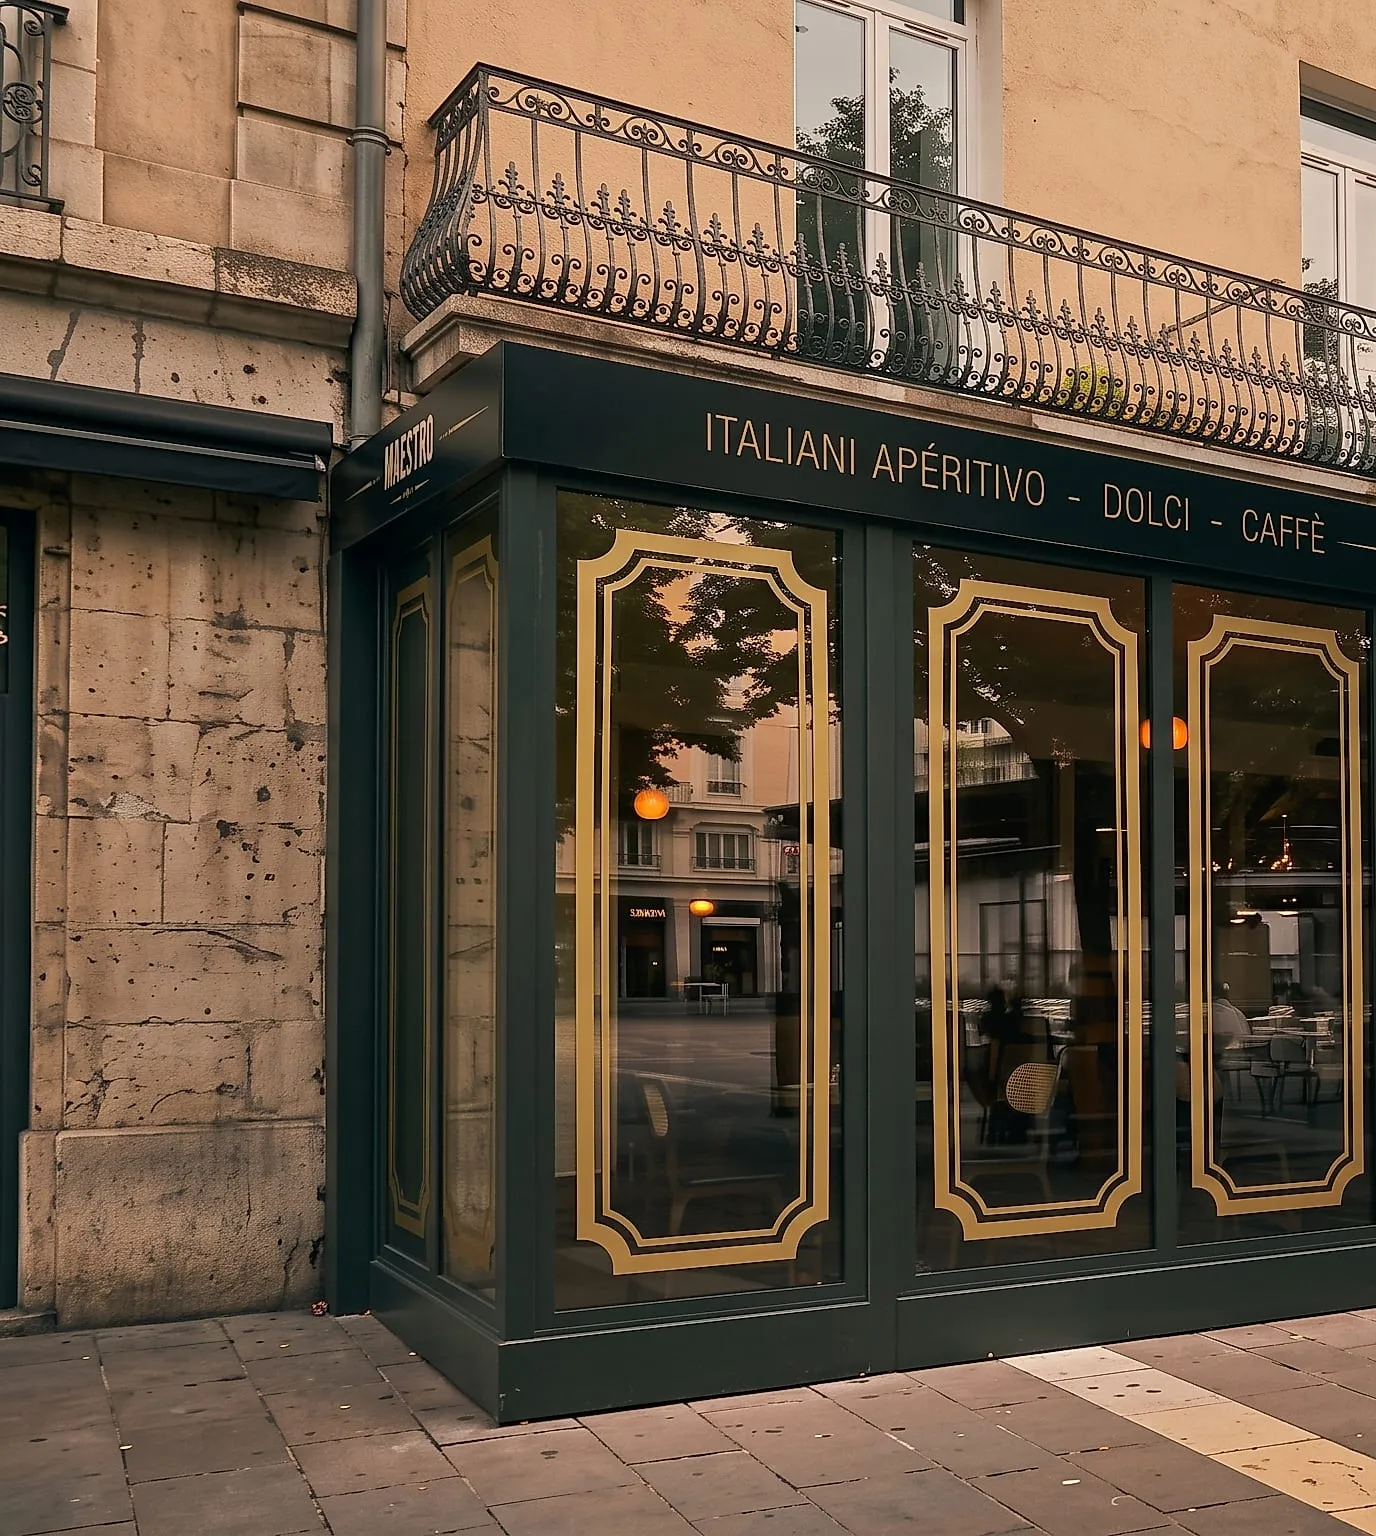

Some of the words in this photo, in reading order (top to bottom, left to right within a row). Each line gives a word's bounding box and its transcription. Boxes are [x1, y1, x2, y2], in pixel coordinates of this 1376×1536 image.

[384, 414, 434, 490] MAESTRO
[706, 412, 856, 476] ITALIANI
[872, 442, 1046, 507] APÉRITIVO
[1104, 483, 1189, 532] DOLCI
[1242, 508, 1326, 554] CAFFÈ
